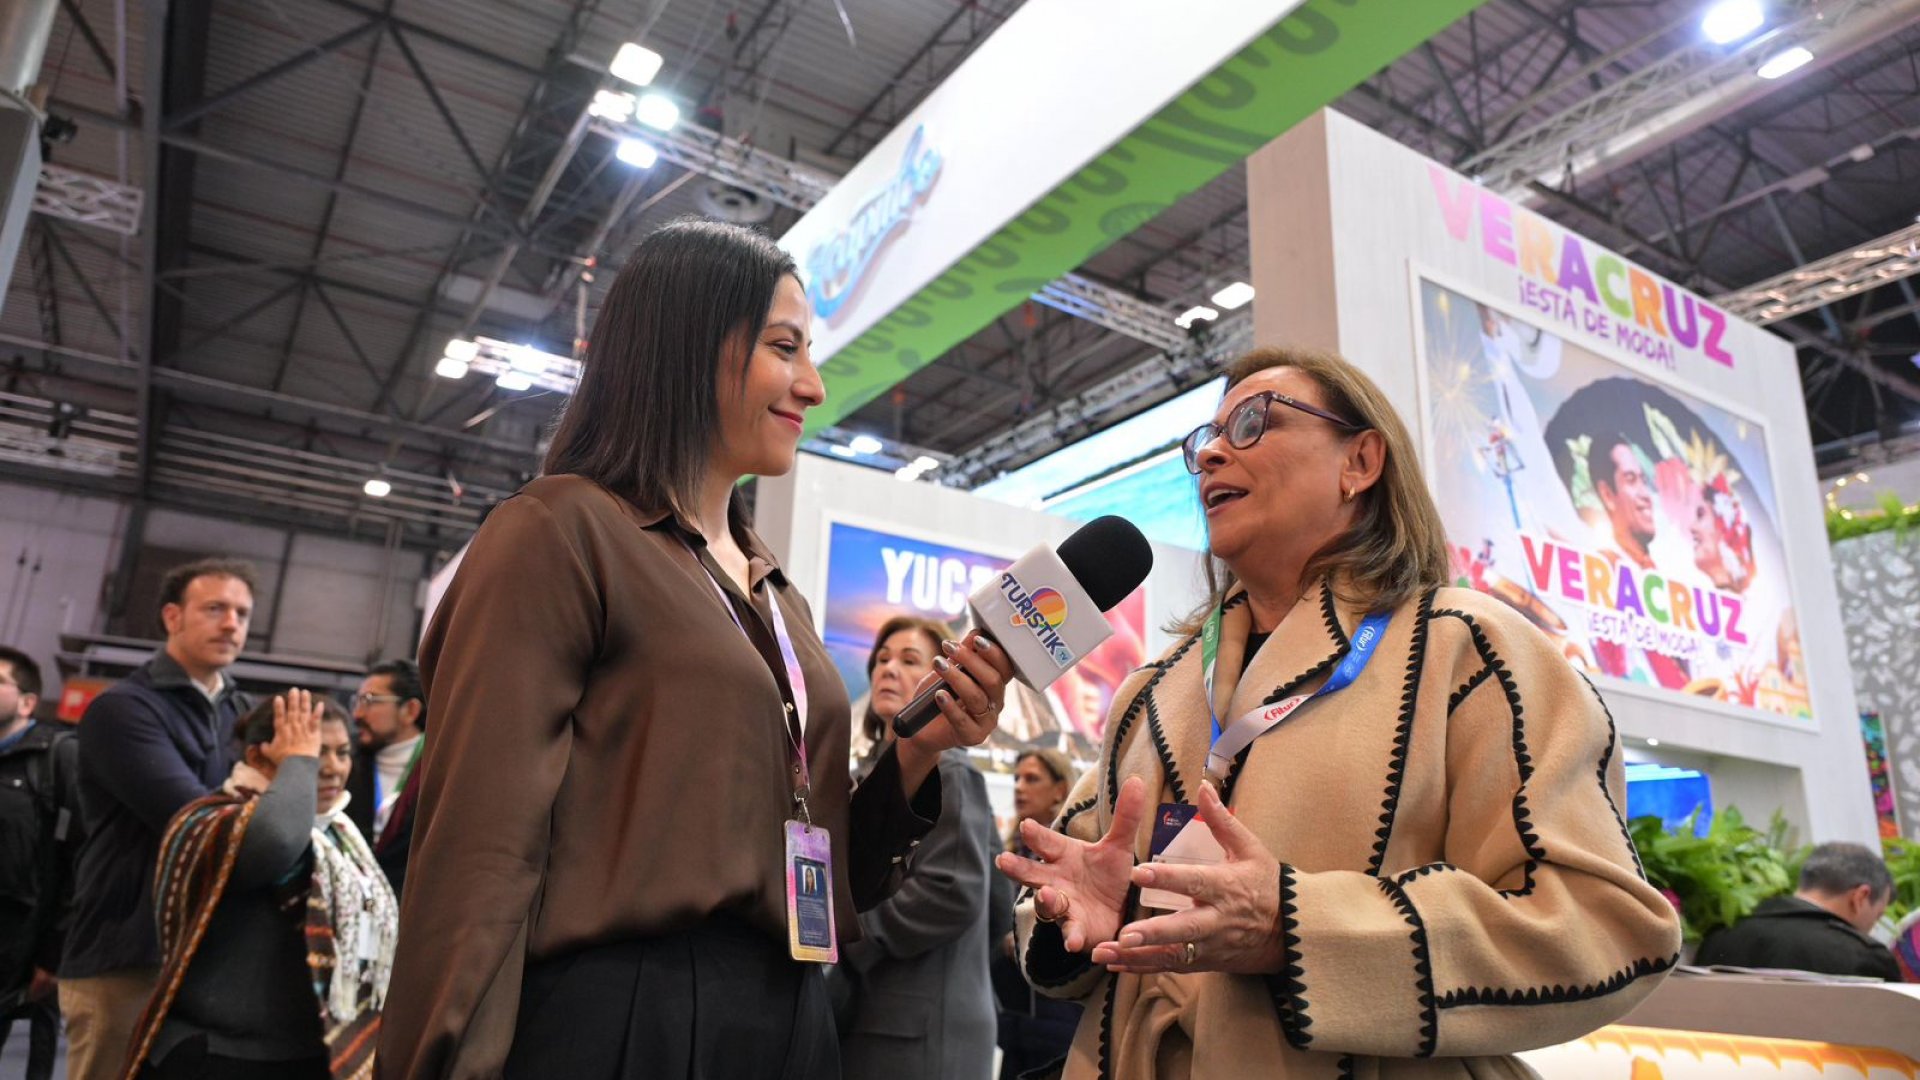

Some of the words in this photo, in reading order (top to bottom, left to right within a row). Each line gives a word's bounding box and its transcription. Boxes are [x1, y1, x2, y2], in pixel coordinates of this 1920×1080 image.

[1428, 165, 1734, 368] VERACRUZ
[1584, 307, 1609, 338] DE
[1617, 323, 1677, 371] MODA!
[881, 547, 1004, 614] YUC
[1001, 572, 1065, 655] TURISTIK
[1520, 534, 1747, 644] VERACRUZ
